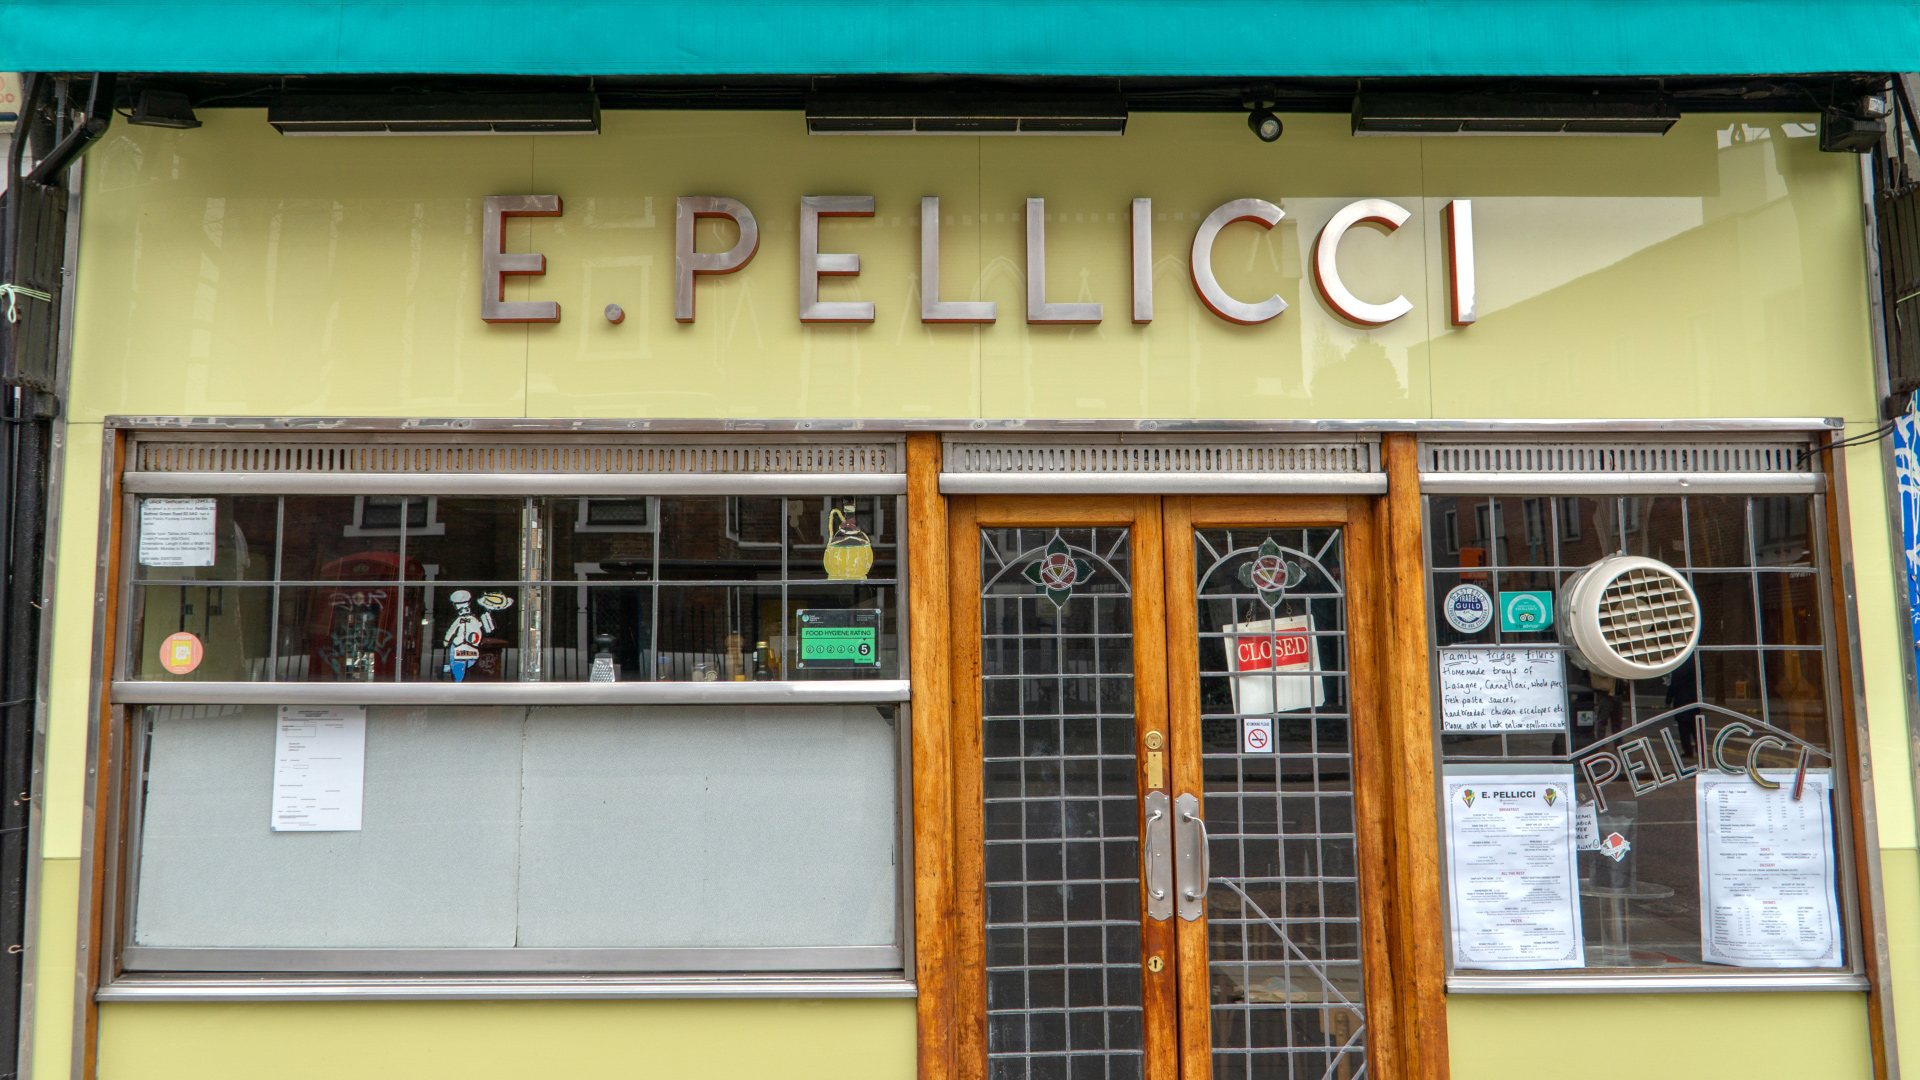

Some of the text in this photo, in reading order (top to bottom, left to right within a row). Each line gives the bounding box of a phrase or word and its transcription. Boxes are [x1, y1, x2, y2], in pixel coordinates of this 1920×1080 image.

[675, 195, 1476, 325] PELLICCI
[861, 645, 868, 654] 5
[1238, 637, 1307, 662] CLOSED
[1442, 666, 1533, 681] Homemade trays of
[1531, 679, 1548, 687] whole
[1462, 696, 1484, 707] pasta
[1466, 721, 1478, 729] ask
[1489, 719, 1503, 728] look
[1580, 715, 1809, 813] PELLICCI
